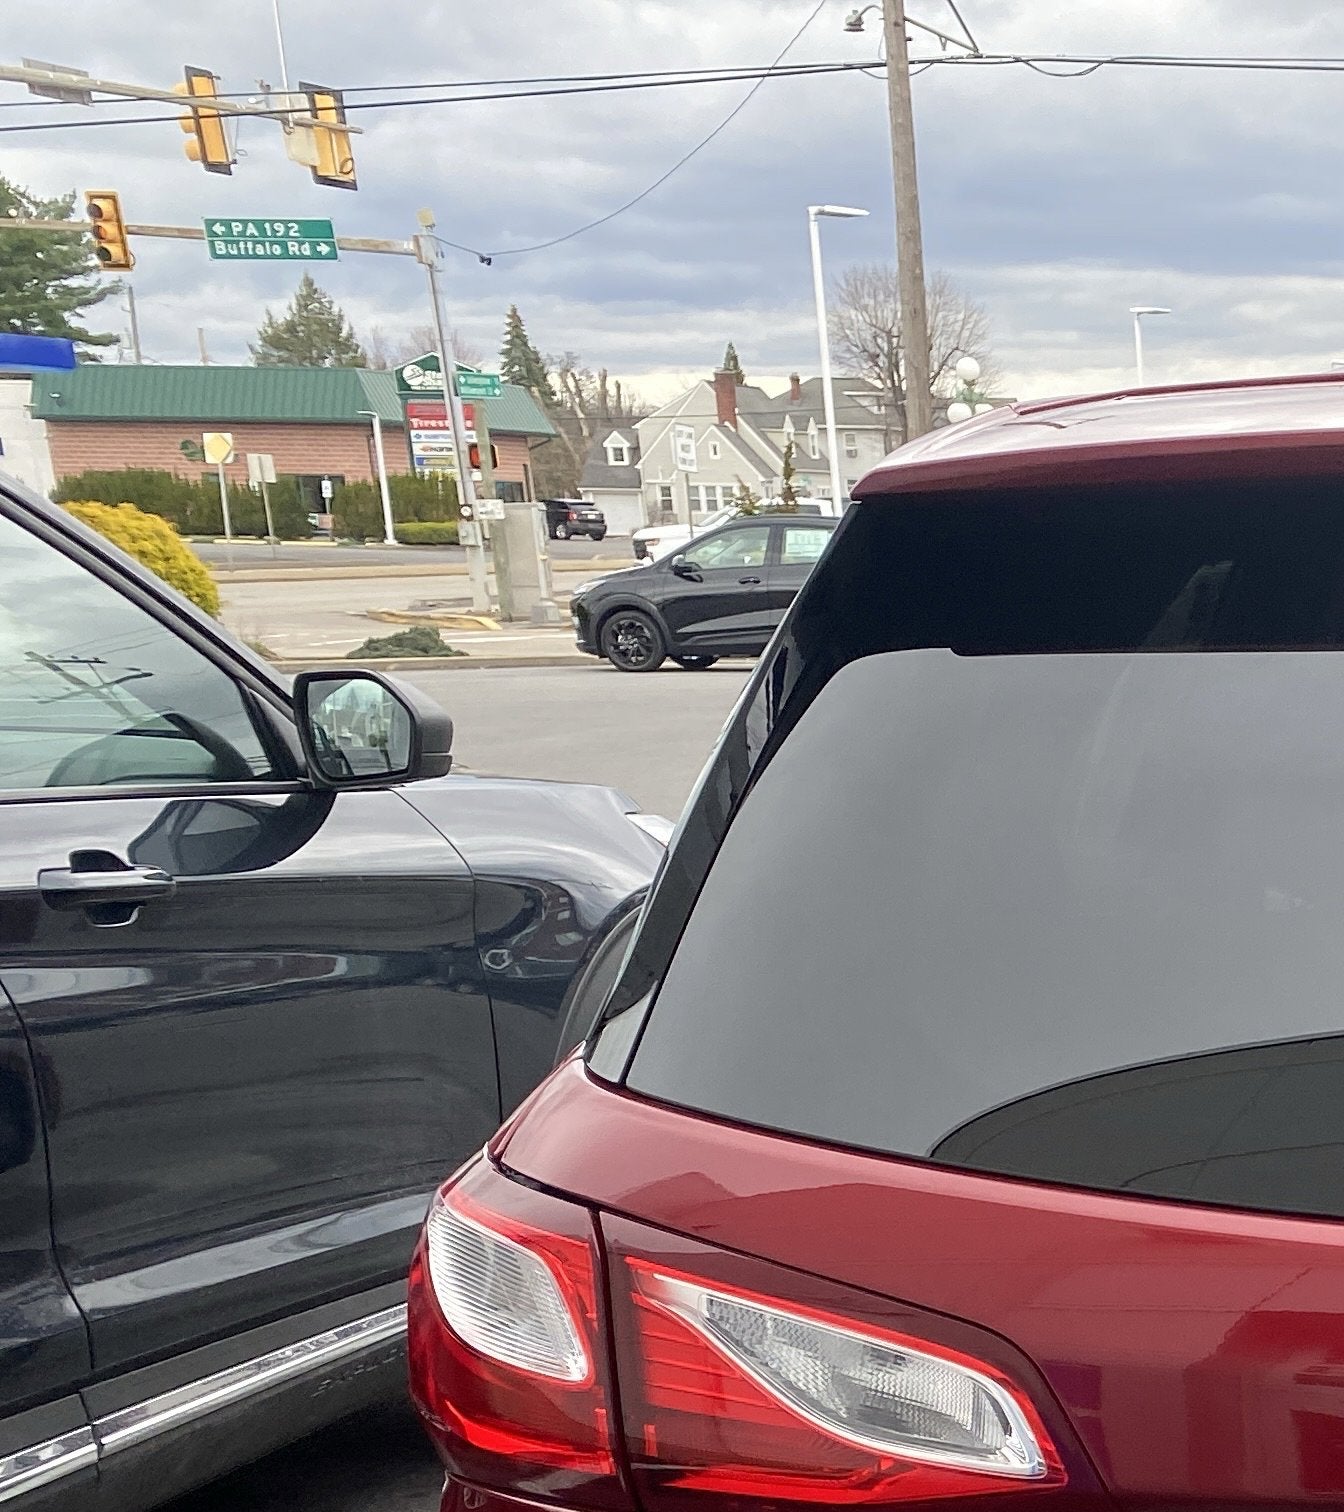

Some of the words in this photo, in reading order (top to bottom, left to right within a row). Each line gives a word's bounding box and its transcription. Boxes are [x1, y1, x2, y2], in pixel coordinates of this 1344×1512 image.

[230, 221, 259, 236] PA
[263, 222, 301, 236] 192
[213, 241, 281, 255] Buffalo
[287, 241, 311, 256] Rd
